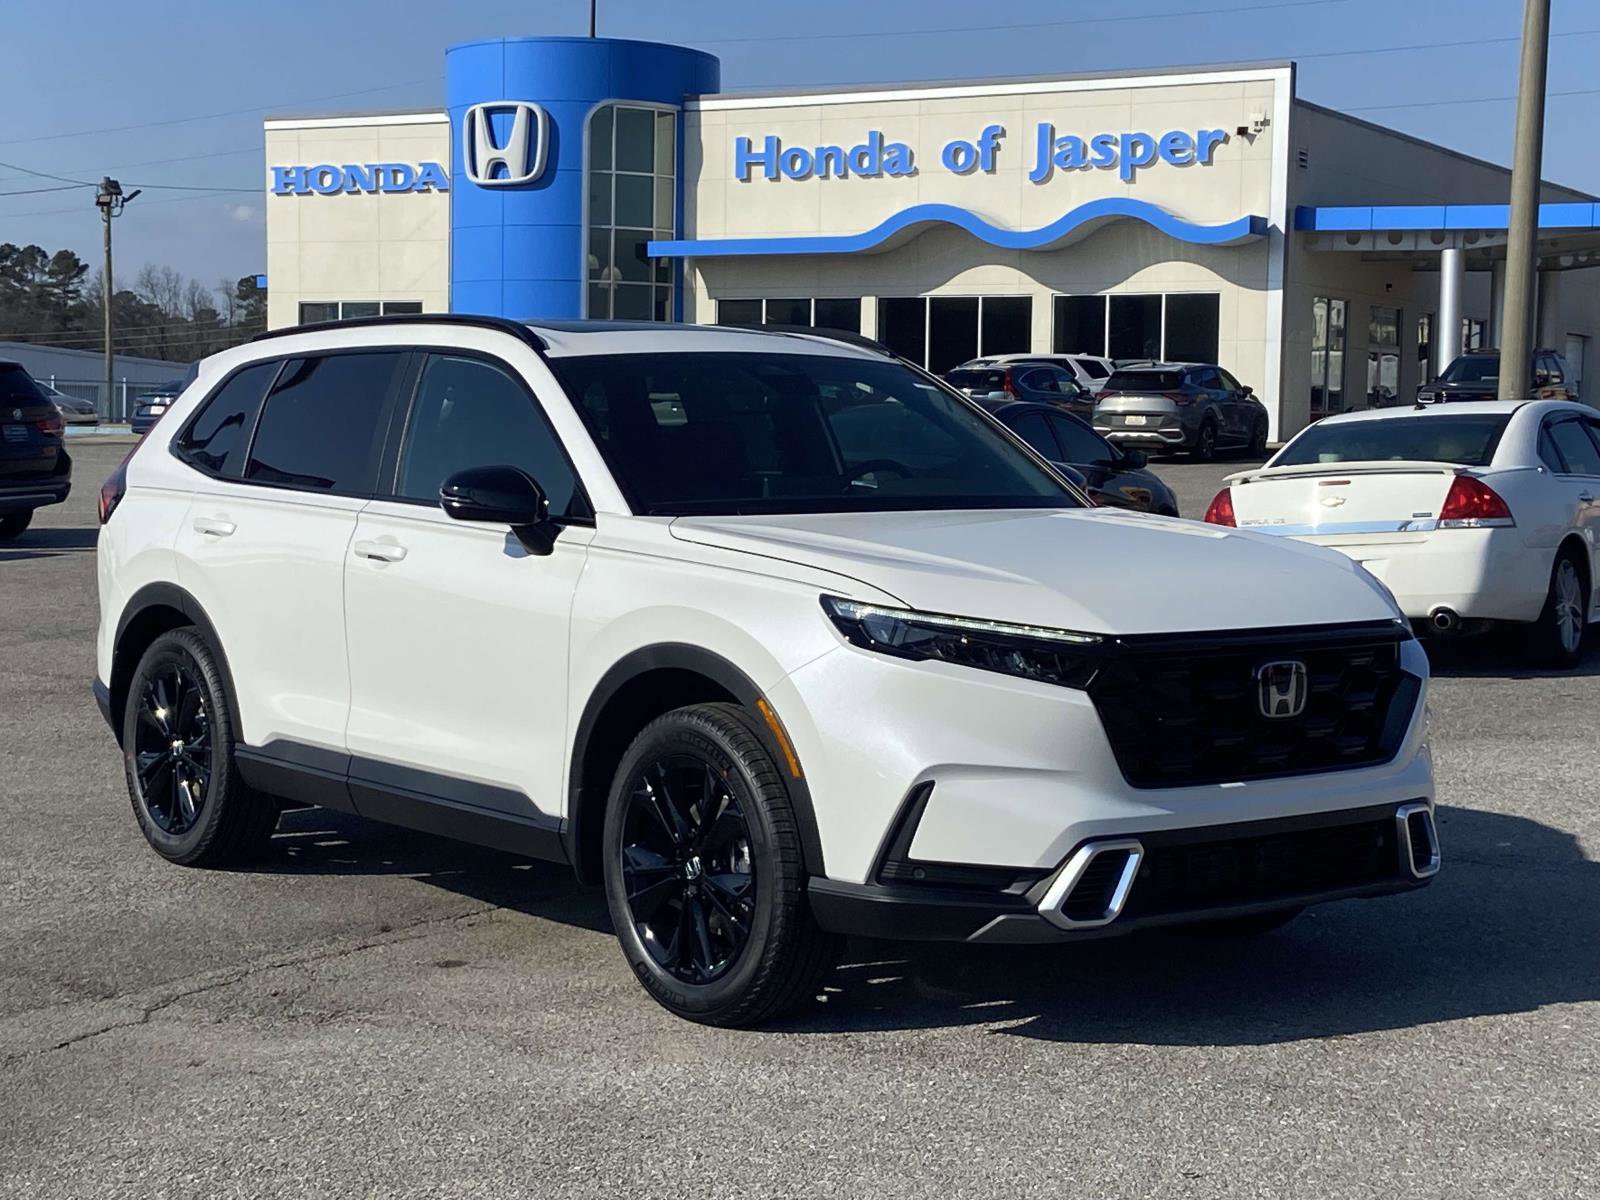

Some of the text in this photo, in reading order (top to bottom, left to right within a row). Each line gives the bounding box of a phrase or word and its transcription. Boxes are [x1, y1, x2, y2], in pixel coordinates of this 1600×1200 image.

[735, 122, 1229, 184] Honda of Jasper
[271, 162, 449, 195] HONDA
